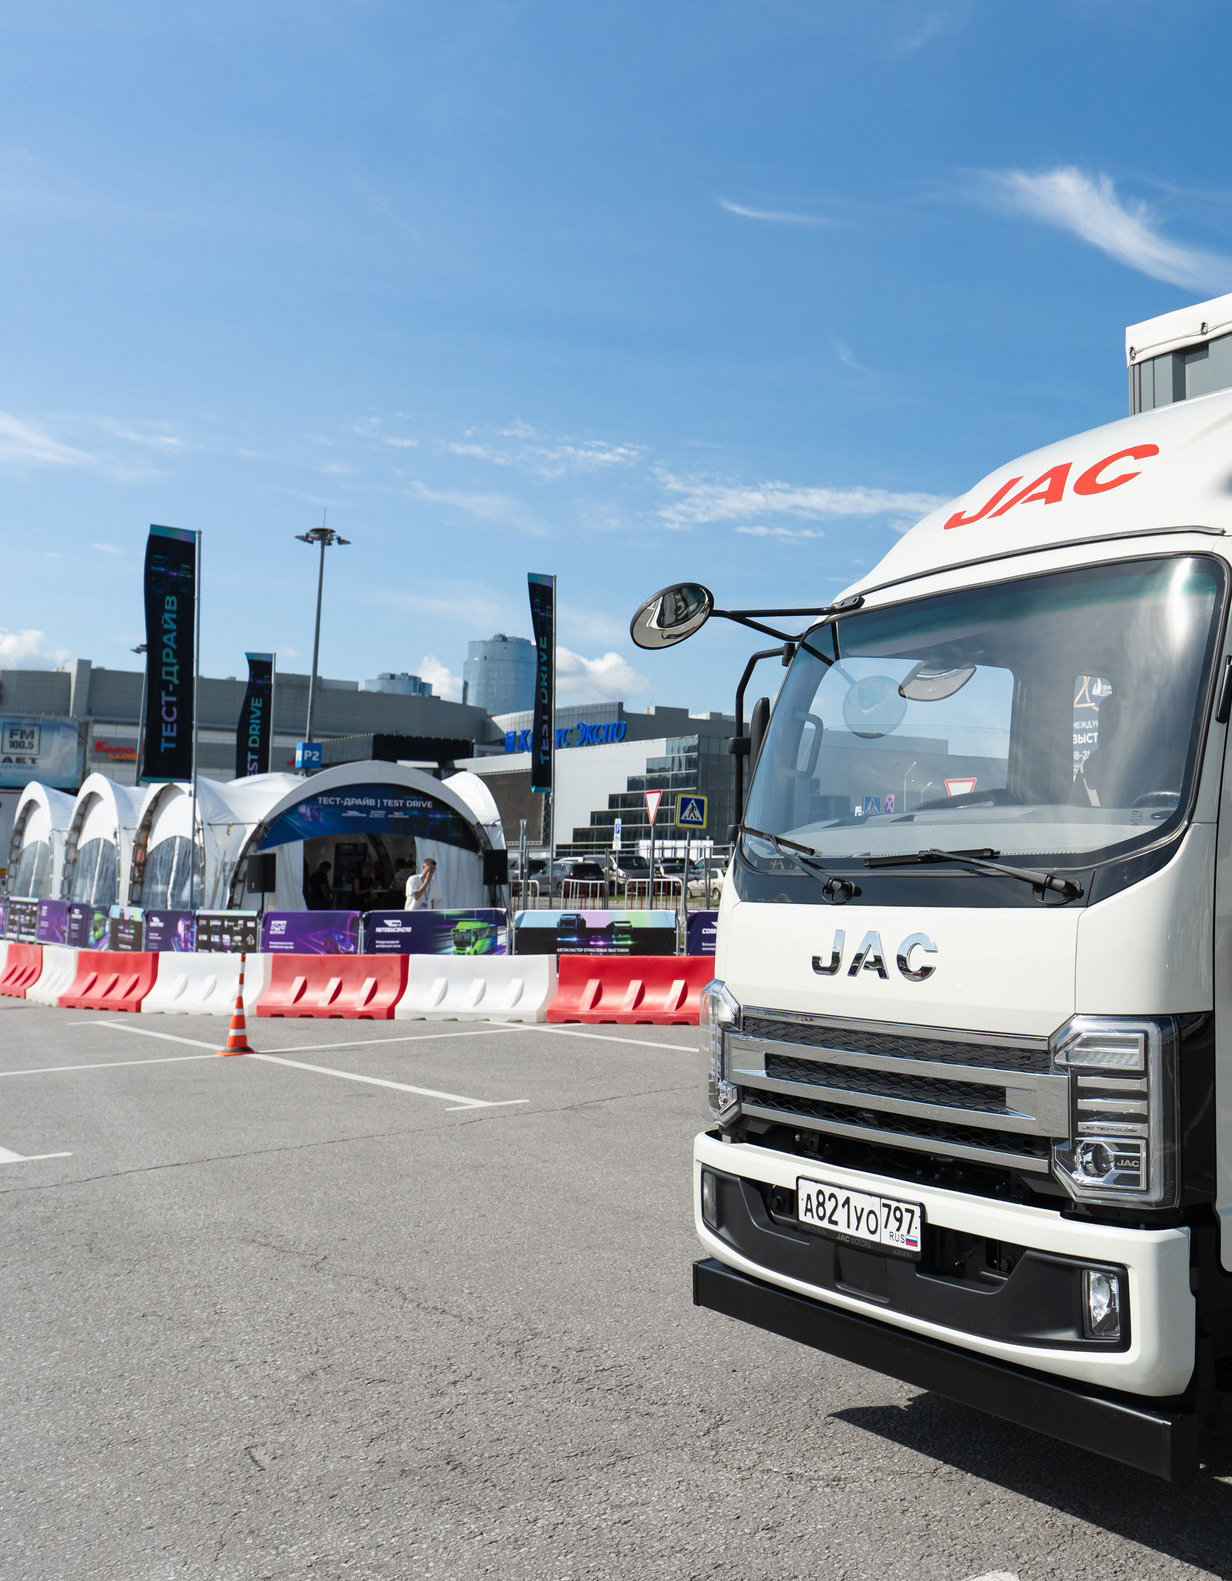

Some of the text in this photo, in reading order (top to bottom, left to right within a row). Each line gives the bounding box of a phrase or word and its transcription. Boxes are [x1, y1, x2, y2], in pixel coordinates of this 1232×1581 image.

[943, 443, 1160, 530] JAC
[160, 595, 178, 752] ТЕСТ-ДРАЙВ
[248, 697, 262, 748] DRIVE
[9, 729, 35, 740] FM
[8, 740, 34, 750] 100.5
[304, 750, 320, 761] P2
[317, 796, 433, 809] ТЕСТ-ДРАЙВ TEST DRIVE
[811, 929, 939, 982] JAC
[1116, 1159, 1140, 1168] JAC
[882, 1202, 915, 1235] 797
[836, 1233, 872, 1249] JAC MOTORS
[889, 1231, 905, 1244] RUS
